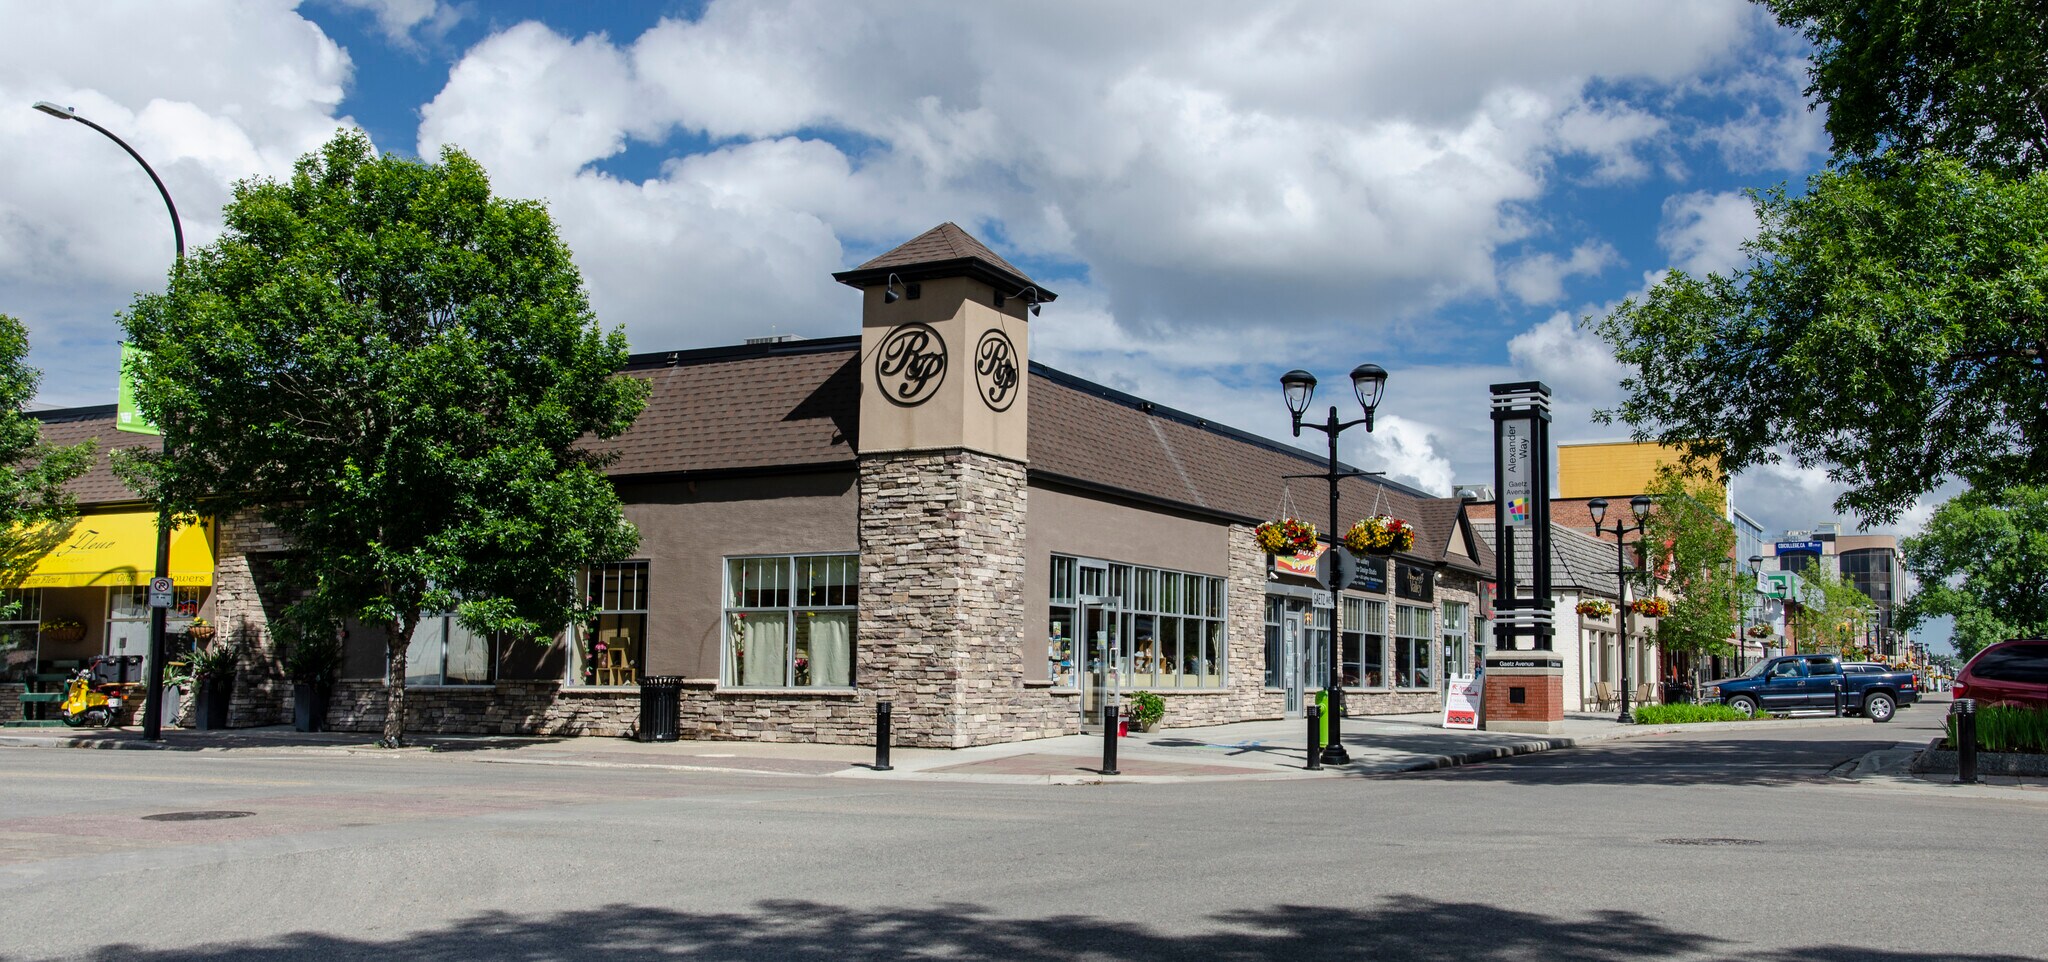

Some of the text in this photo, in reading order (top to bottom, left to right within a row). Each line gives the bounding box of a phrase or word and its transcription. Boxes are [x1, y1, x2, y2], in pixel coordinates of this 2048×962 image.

[1507, 425, 1517, 473] Alexander
[1519, 438, 1530, 460] Way
[1291, 557, 1316, 572] Corn
[171, 572, 205, 583] lowers
[1313, 592, 1326, 606] GAETZ
